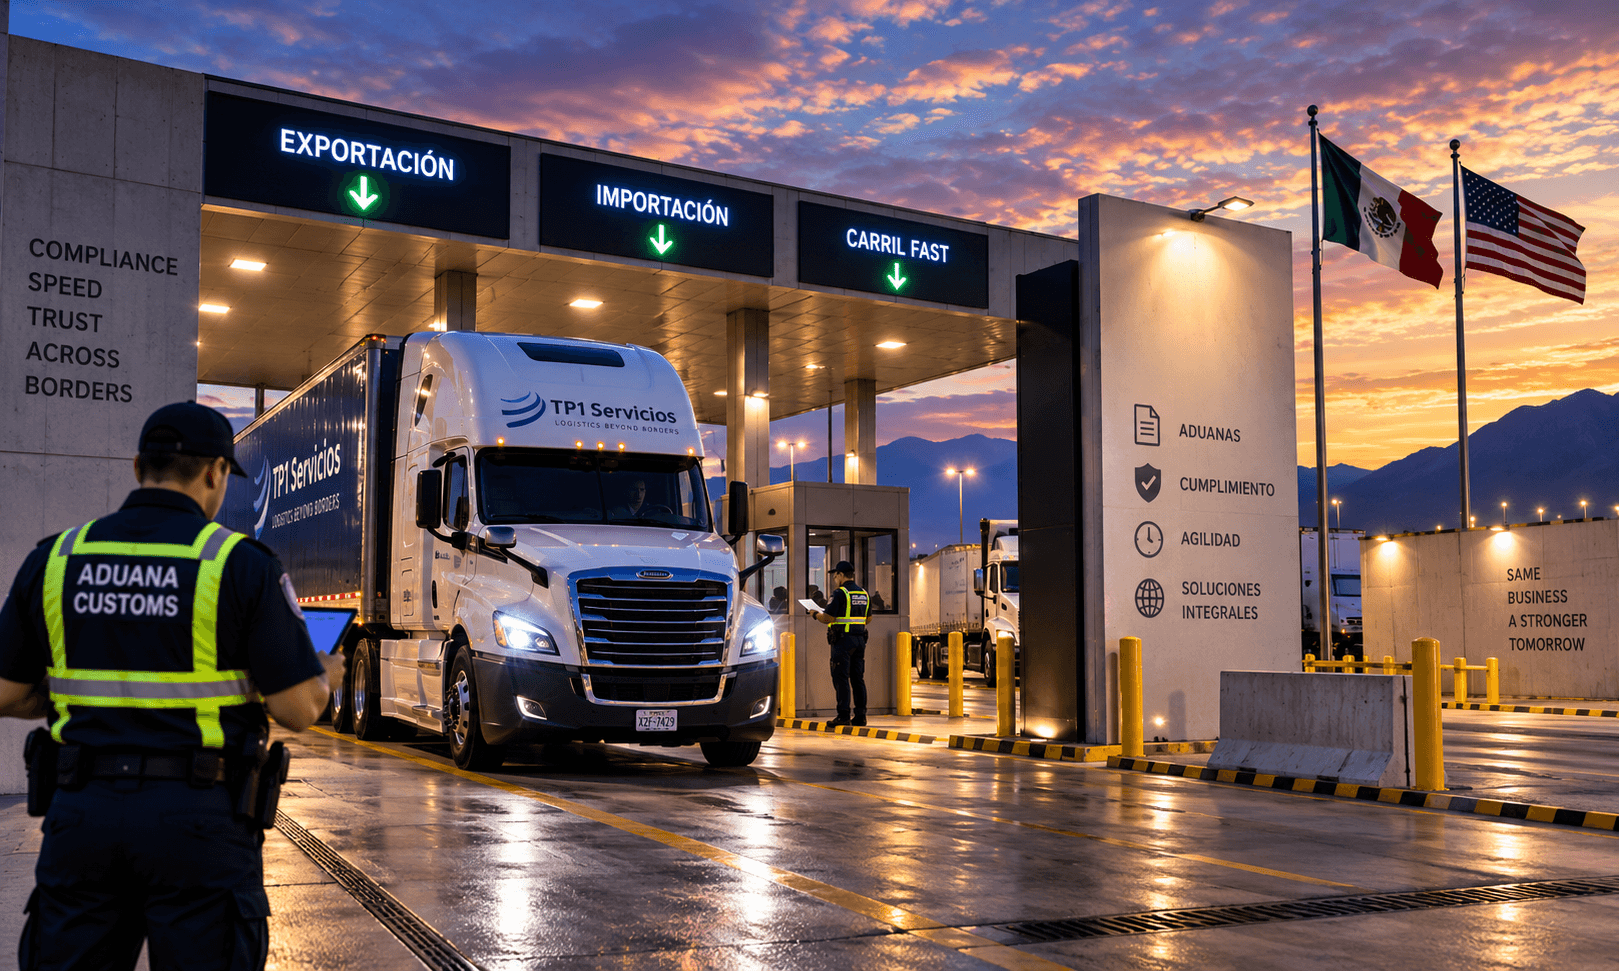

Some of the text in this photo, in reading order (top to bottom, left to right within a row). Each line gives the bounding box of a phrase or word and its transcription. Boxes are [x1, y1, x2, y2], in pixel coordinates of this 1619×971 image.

[280, 128, 454, 181] EXPORTACIÓN
[596, 184, 728, 227] IMPORTACIÓN
[29, 238, 178, 276] COMPLIANCE
[846, 228, 949, 263] CARRIL FAST
[28, 272, 102, 299] SPEED
[27, 306, 103, 333] TRUST
[25, 341, 120, 368] ACROSS
[25, 375, 133, 403] BORDERS
[550, 399, 677, 424] TP1 Servicios
[555, 420, 600, 429] LOGISTICS
[604, 423, 638, 431] BEYOND
[1179, 423, 1241, 442] ADUANAS
[273, 438, 340, 499] TP1 Servicios
[1180, 477, 1275, 497] CUMPLIMIENTO
[1181, 531, 1241, 547] AGILIDAD
[76, 563, 179, 588] ADUANA
[1507, 567, 1541, 581] SAME
[1182, 581, 1261, 597] SOLUCIONES
[1508, 589, 1568, 604] BUSINESS
[73, 592, 179, 617] CUSTOMS
[1182, 605, 1258, 620] INTEGRALES
[1508, 613, 1588, 628] A STRONGER
[1509, 637, 1585, 651] TOMORROW
